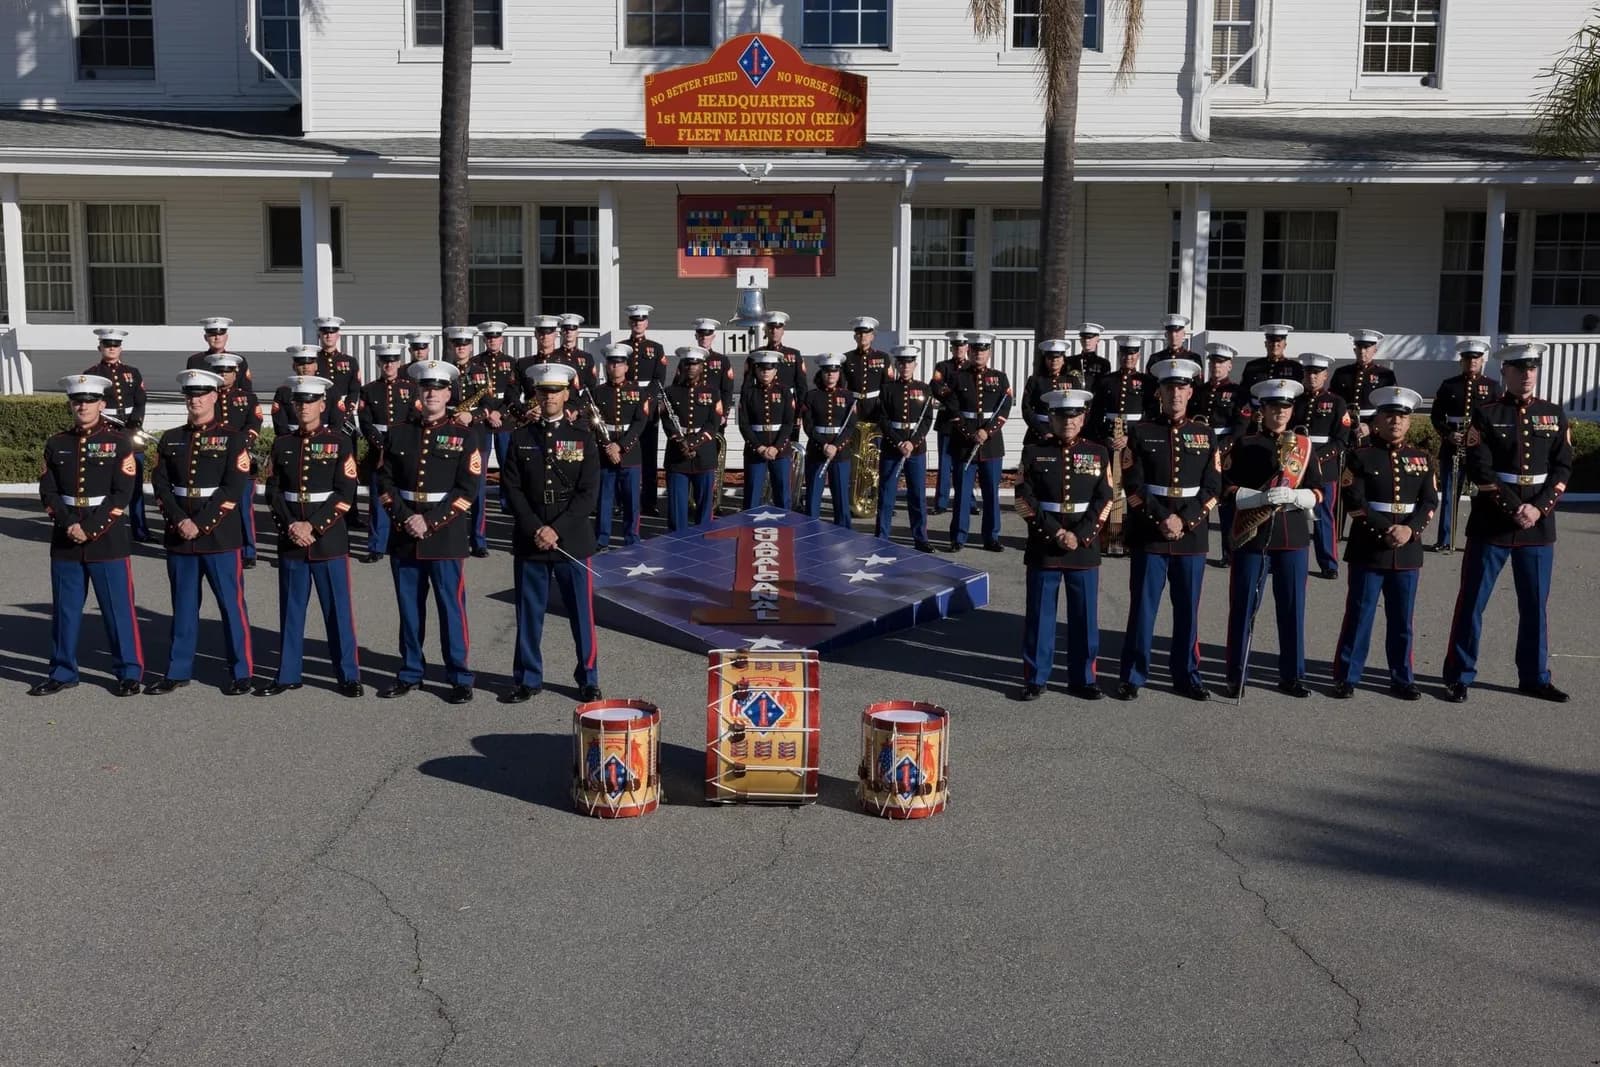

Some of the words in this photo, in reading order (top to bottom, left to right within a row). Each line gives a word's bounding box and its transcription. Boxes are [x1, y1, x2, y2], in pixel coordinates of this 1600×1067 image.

[650, 92, 665, 107] NO
[666, 78, 702, 99] BETTER
[703, 71, 738, 86] FRIEND
[777, 71, 792, 83] NO
[794, 74, 828, 92] WORSE
[697, 94, 816, 109] HEADQUARTERS
[657, 111, 676, 124] 1st
[679, 111, 737, 124] MARINE
[741, 112, 806, 125] DIVISION
[810, 111, 855, 126] (REIN)
[677, 128, 721, 141] FLEET
[724, 128, 784, 141] MARINE
[786, 129, 834, 142] FORCE
[750, 527, 780, 621] GUADALCANAL
